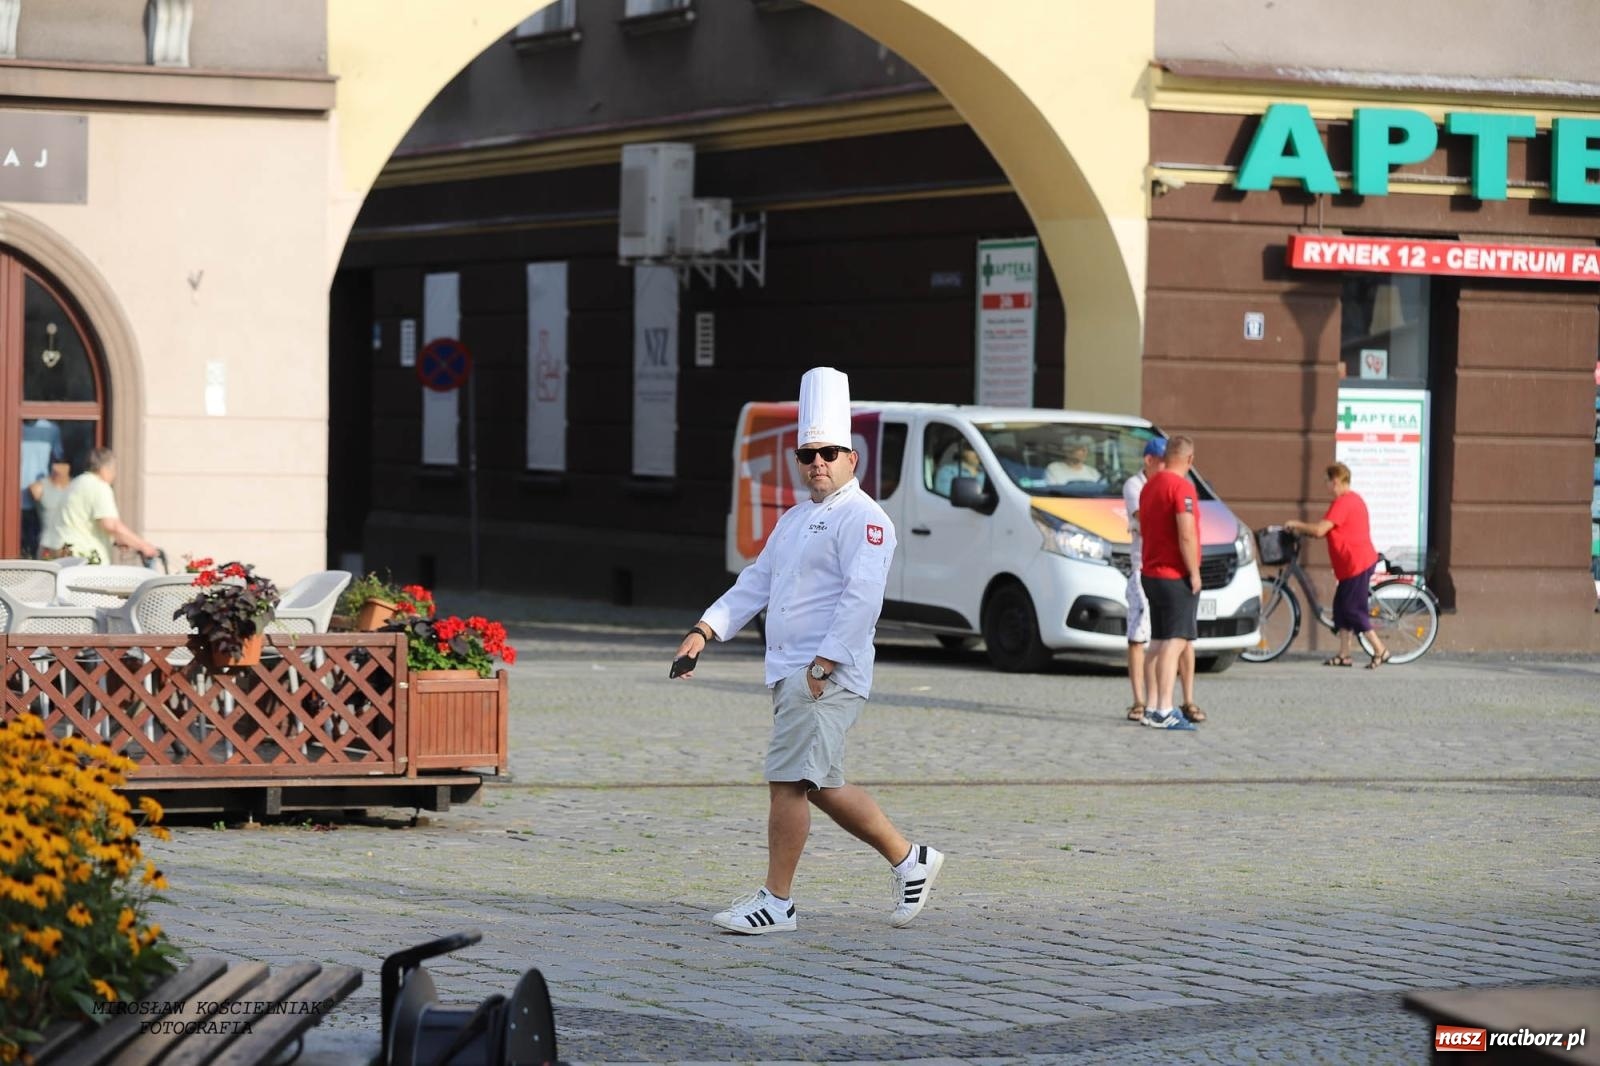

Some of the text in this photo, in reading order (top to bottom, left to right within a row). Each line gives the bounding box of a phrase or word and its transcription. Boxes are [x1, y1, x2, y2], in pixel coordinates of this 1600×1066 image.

[1303, 241, 1390, 266] RYNEK
[1397, 246, 1426, 268] 12
[1447, 251, 1566, 274] CENTRUM
[1571, 253, 1600, 276] FA
[1360, 413, 1417, 424] APTEKA
